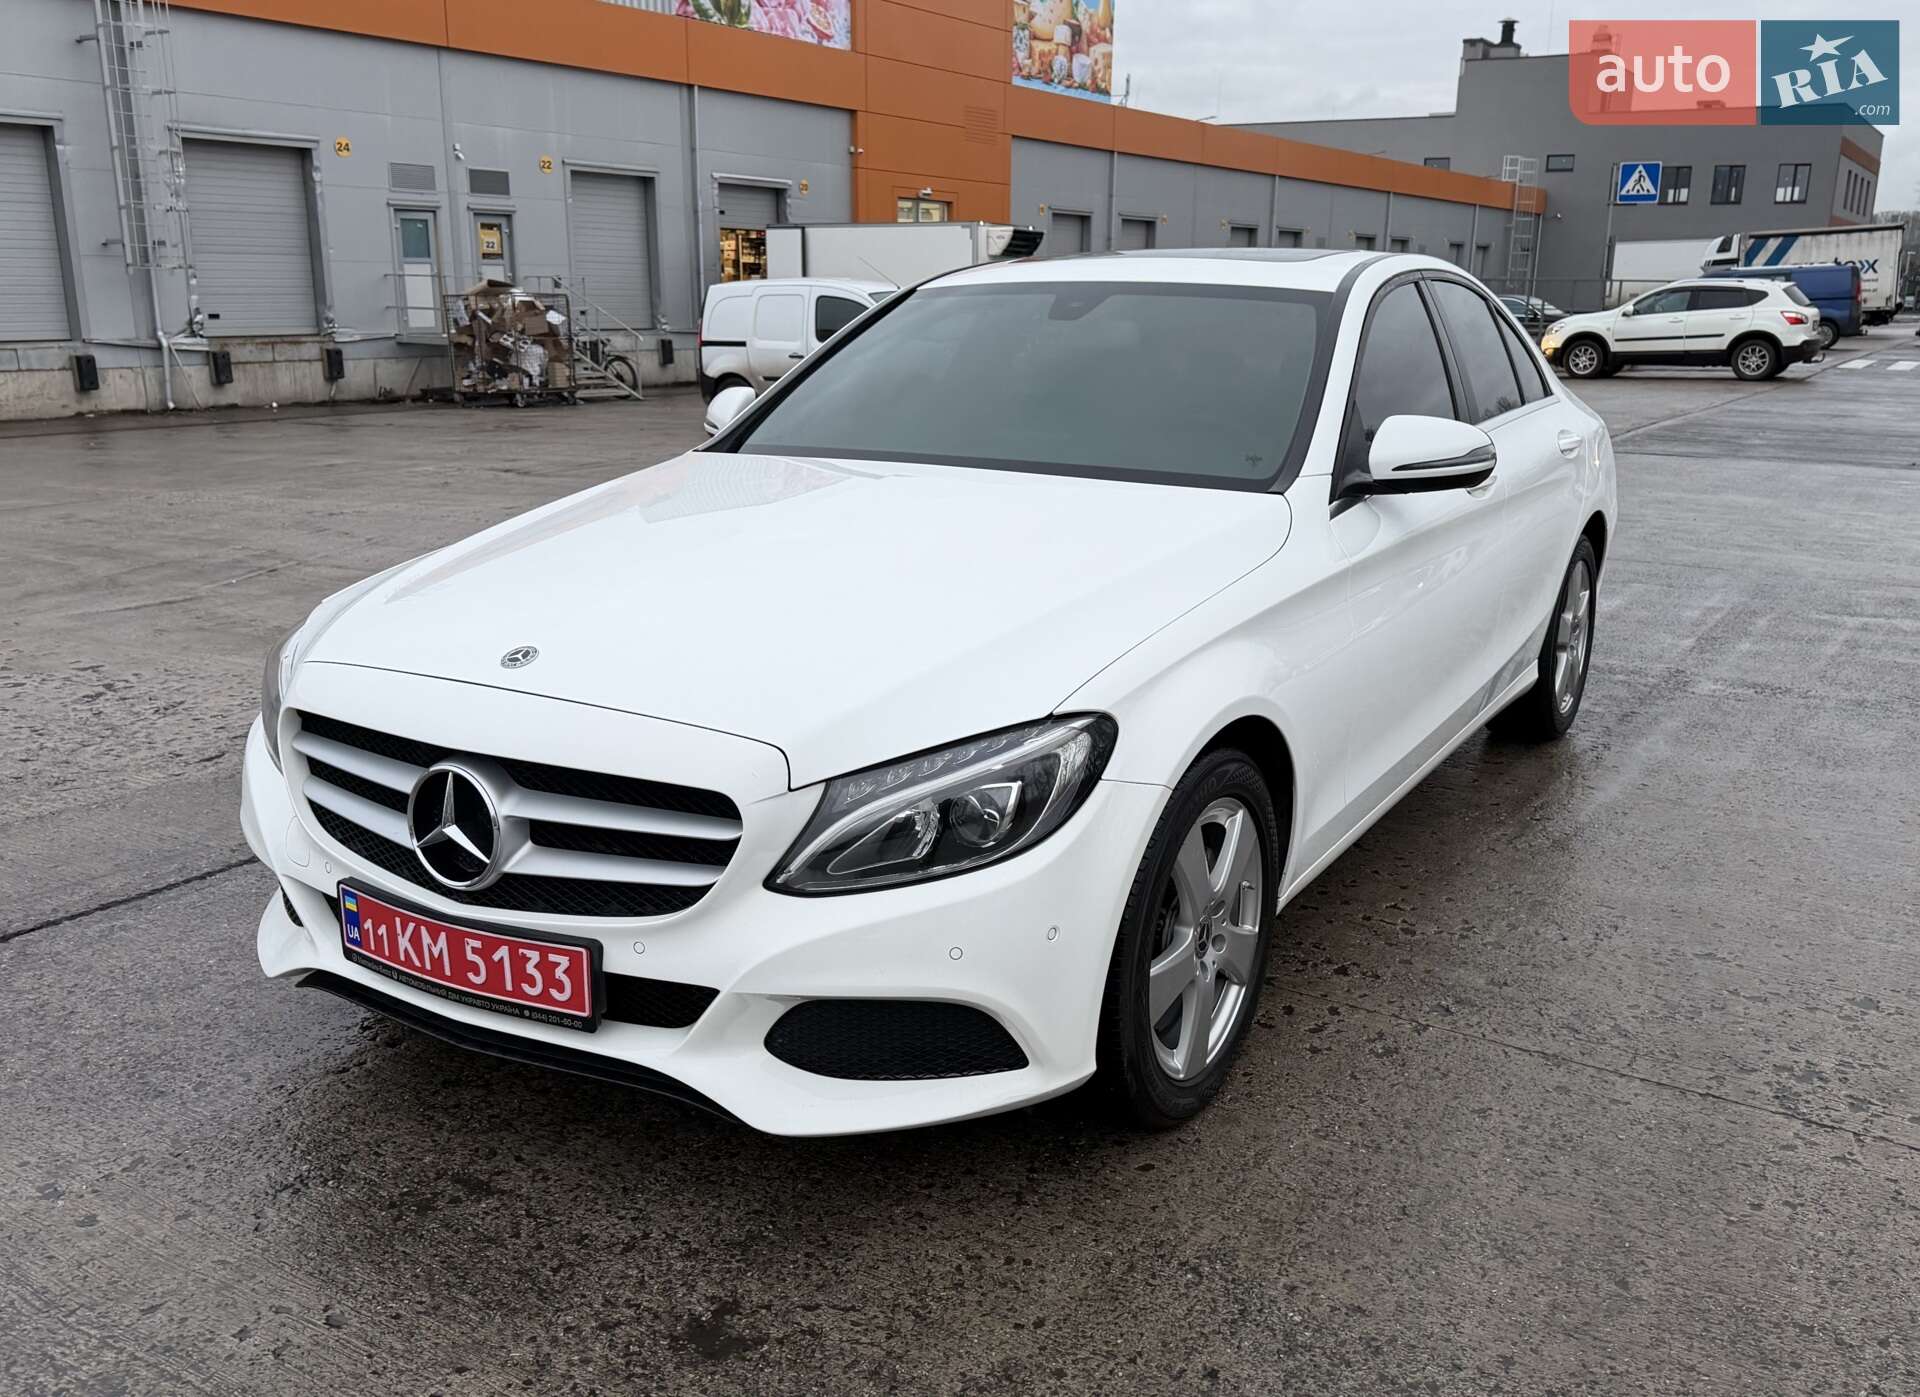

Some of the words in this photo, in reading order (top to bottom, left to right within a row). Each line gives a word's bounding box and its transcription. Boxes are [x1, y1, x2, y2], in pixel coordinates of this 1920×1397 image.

[336, 142, 350, 152] 24
[540, 160, 552, 170] 22
[485, 241, 496, 249] 22
[347, 923, 360, 942] UA
[464, 937, 572, 1002] 5133
